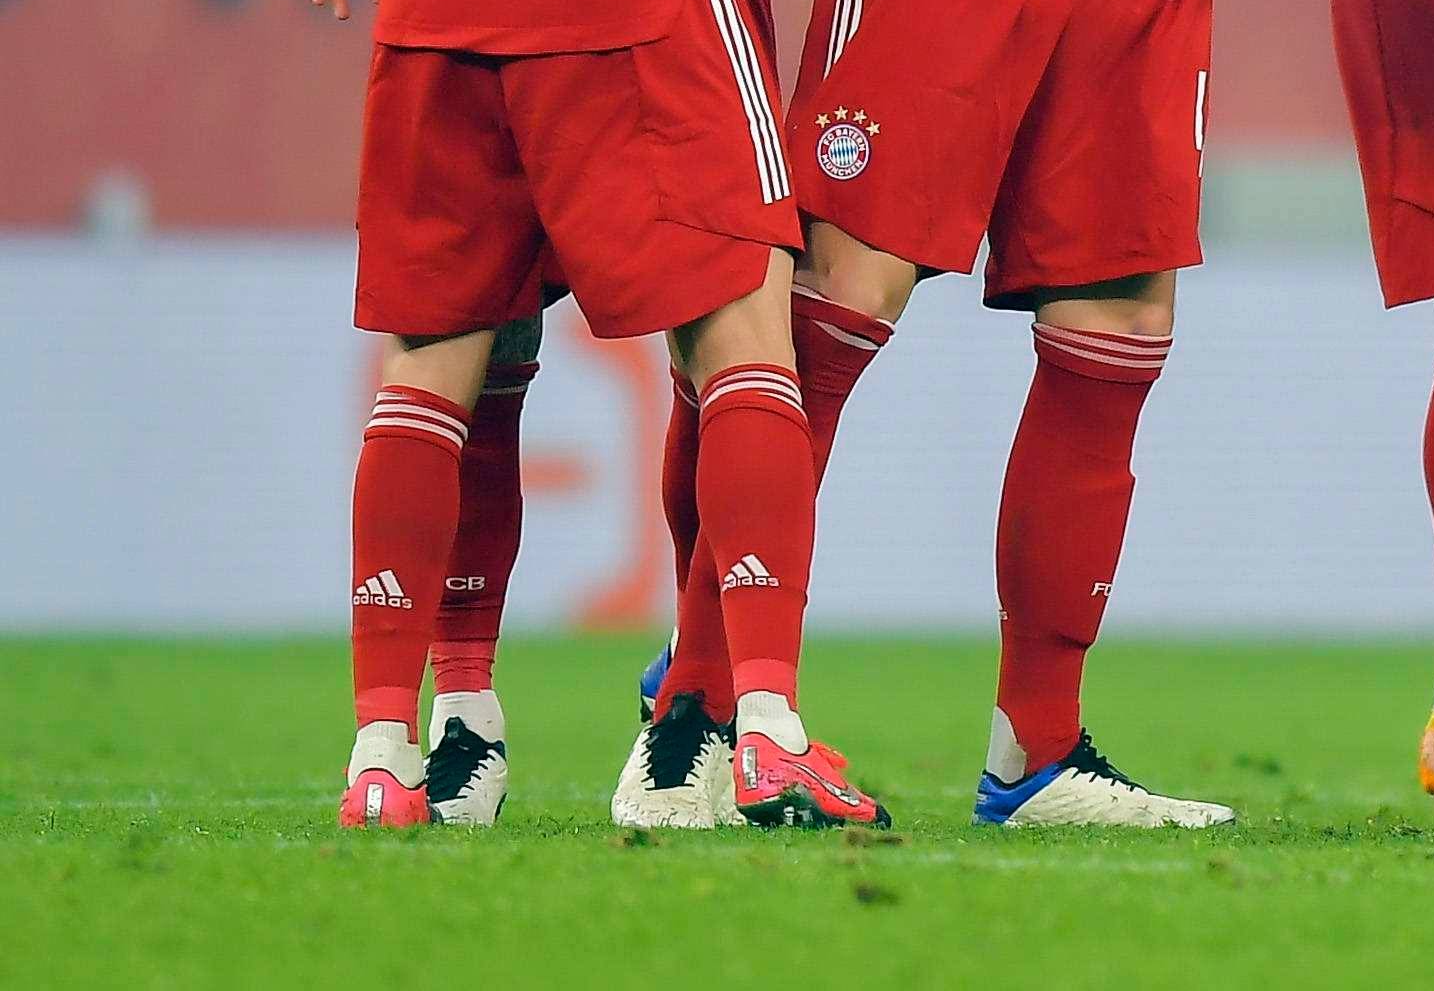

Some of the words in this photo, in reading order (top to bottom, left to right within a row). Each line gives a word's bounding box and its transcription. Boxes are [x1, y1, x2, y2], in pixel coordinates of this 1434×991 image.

[445, 576, 486, 591] CB
[1090, 581, 1113, 597] FC
[353, 594, 413, 610] adidas
